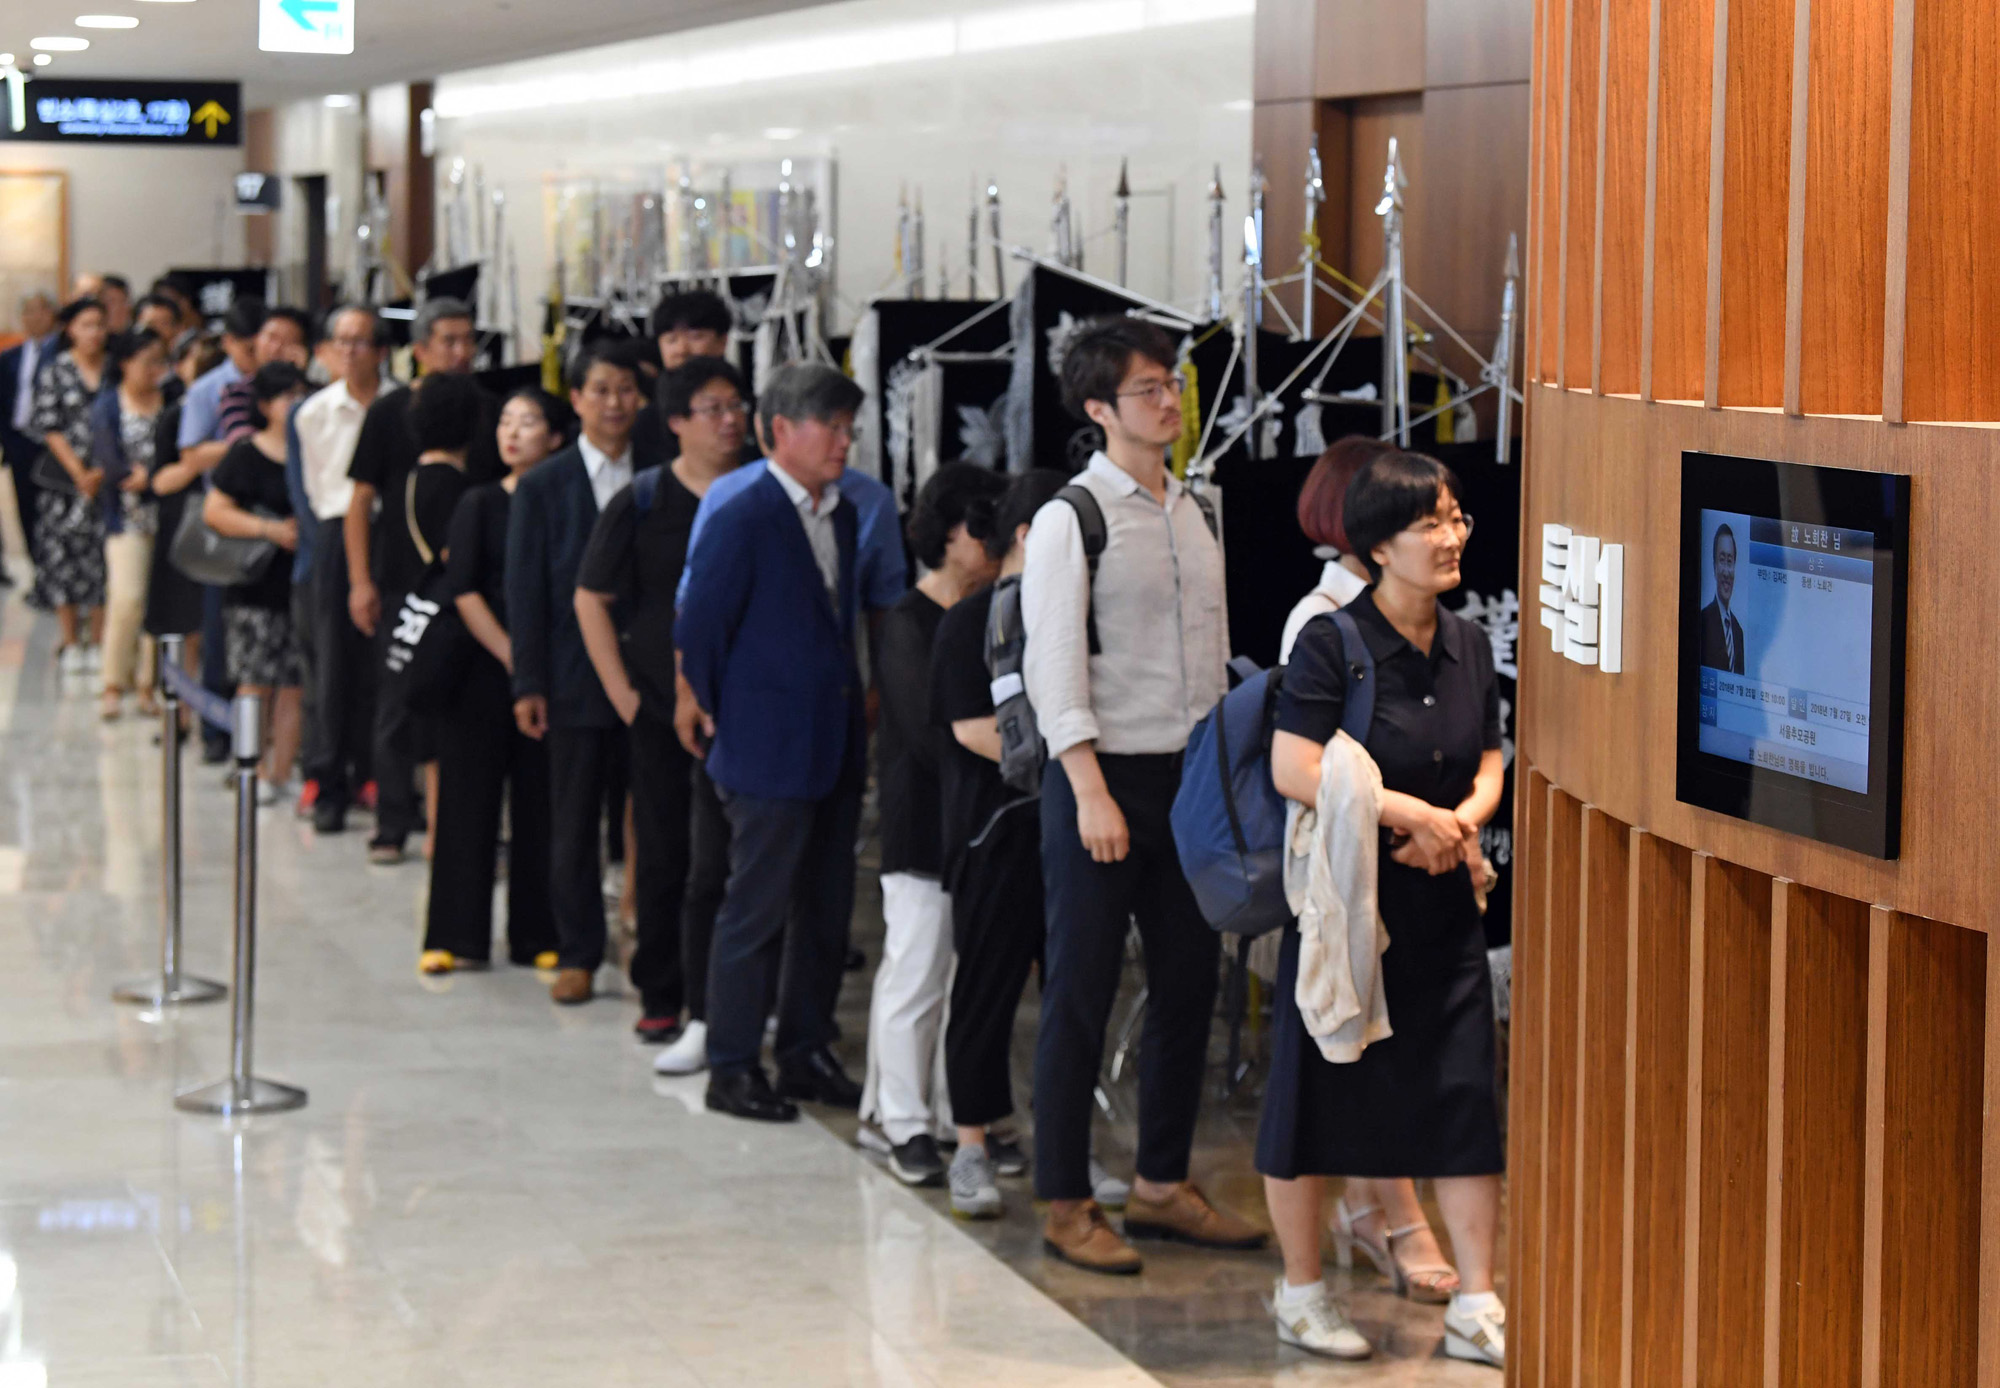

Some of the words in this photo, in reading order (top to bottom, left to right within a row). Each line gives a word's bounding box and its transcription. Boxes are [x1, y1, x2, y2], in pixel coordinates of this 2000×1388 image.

[1791, 526, 1799, 544] 故
[1803, 528, 1828, 548] 노회찬
[1833, 532, 1841, 550] 님
[1760, 690, 1770, 703] 오전
[1810, 703, 1828, 717] 2018년
[1829, 707, 1838, 719] 7월
[1840, 710, 1851, 722] 27일
[1856, 713, 1867, 726] 오전
[1779, 723, 1816, 746] 서울추모공원
[1757, 749, 1786, 769] 노회찬님의
[1788, 758, 1806, 774] 명복을
[1809, 762, 1829, 781] 빕니다.
